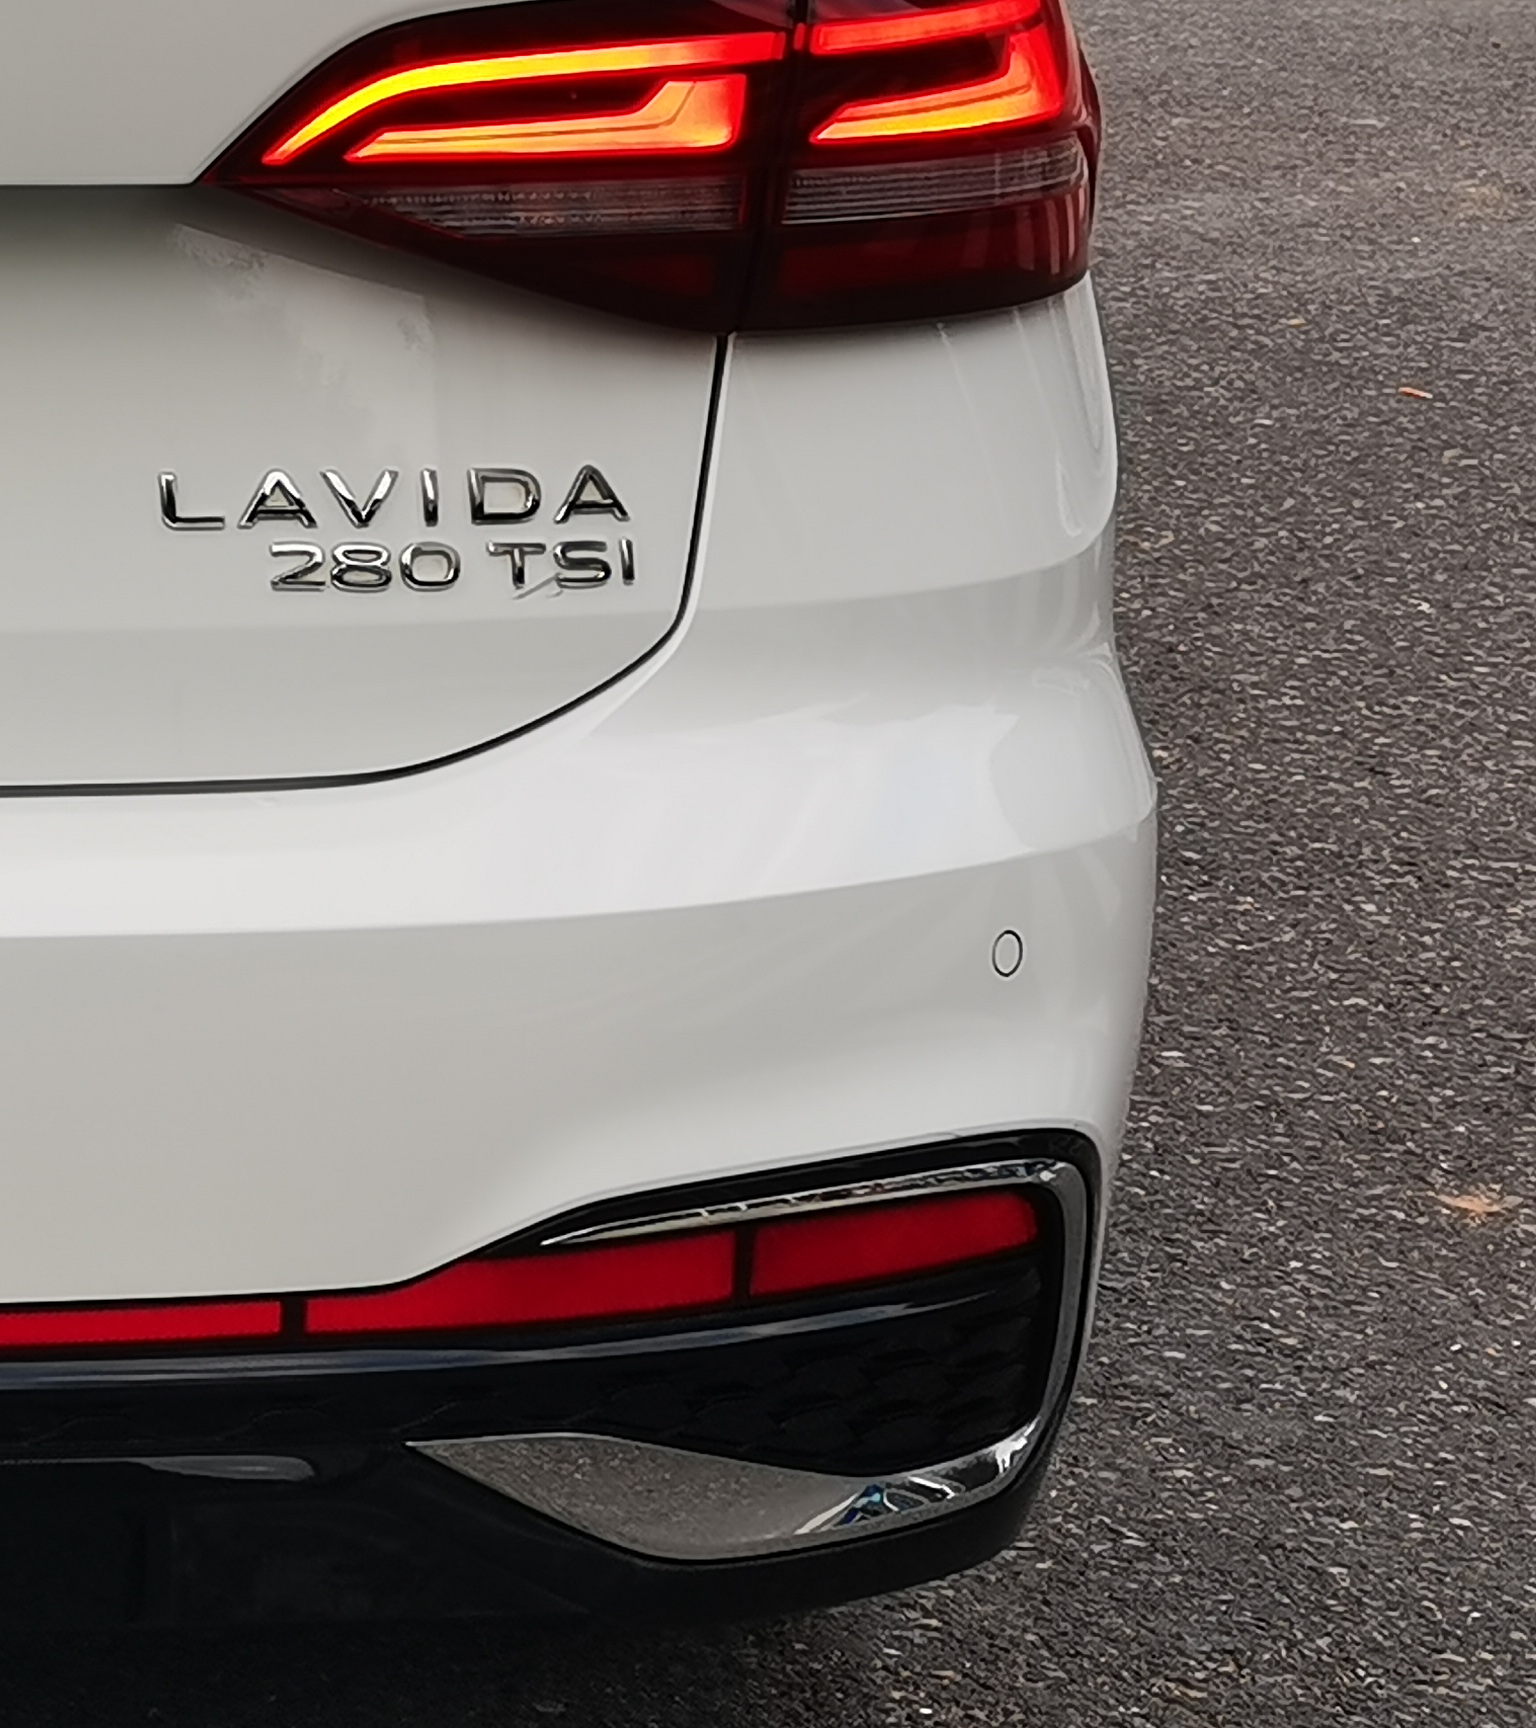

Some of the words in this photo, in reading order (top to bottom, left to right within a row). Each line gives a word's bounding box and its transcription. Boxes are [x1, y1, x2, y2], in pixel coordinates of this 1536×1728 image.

[157, 464, 631, 530] LAVIDA
[268, 540, 462, 591] 280
[485, 537, 636, 590] TSI
